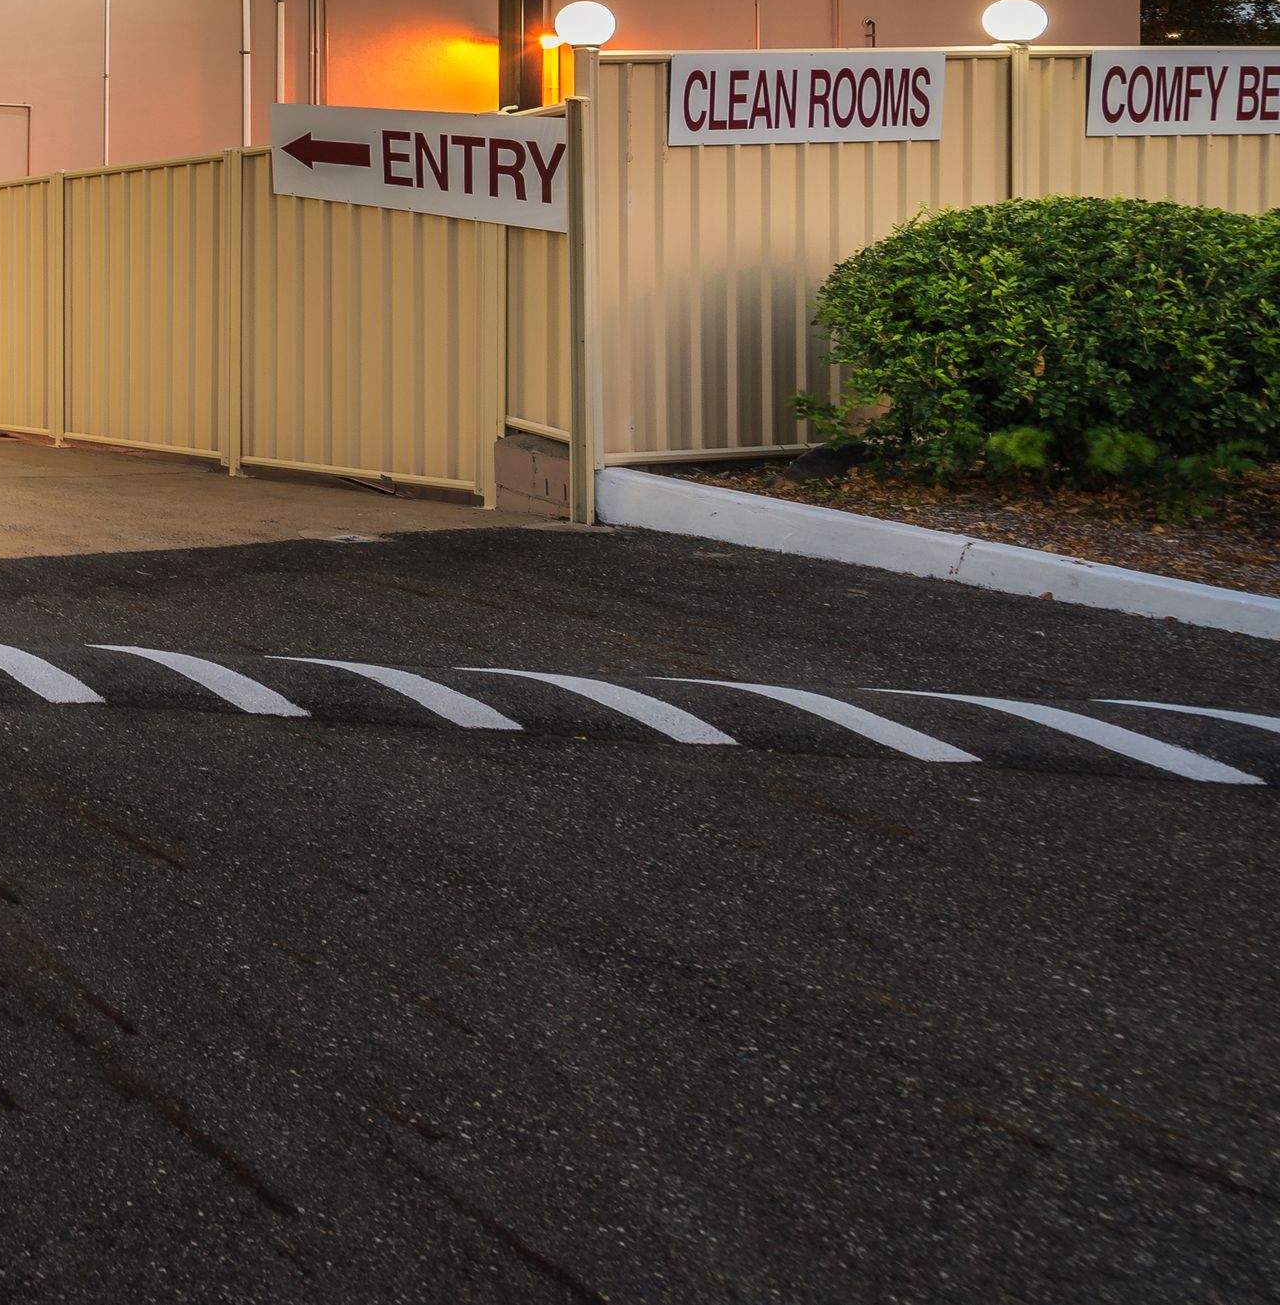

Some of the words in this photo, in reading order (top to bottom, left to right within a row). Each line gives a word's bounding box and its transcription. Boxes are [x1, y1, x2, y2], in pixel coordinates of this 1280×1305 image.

[683, 69, 798, 133] CLEAN
[808, 66, 931, 129] ROOMS
[1101, 65, 1229, 124] COMFY
[382, 130, 566, 204] ENTRY
